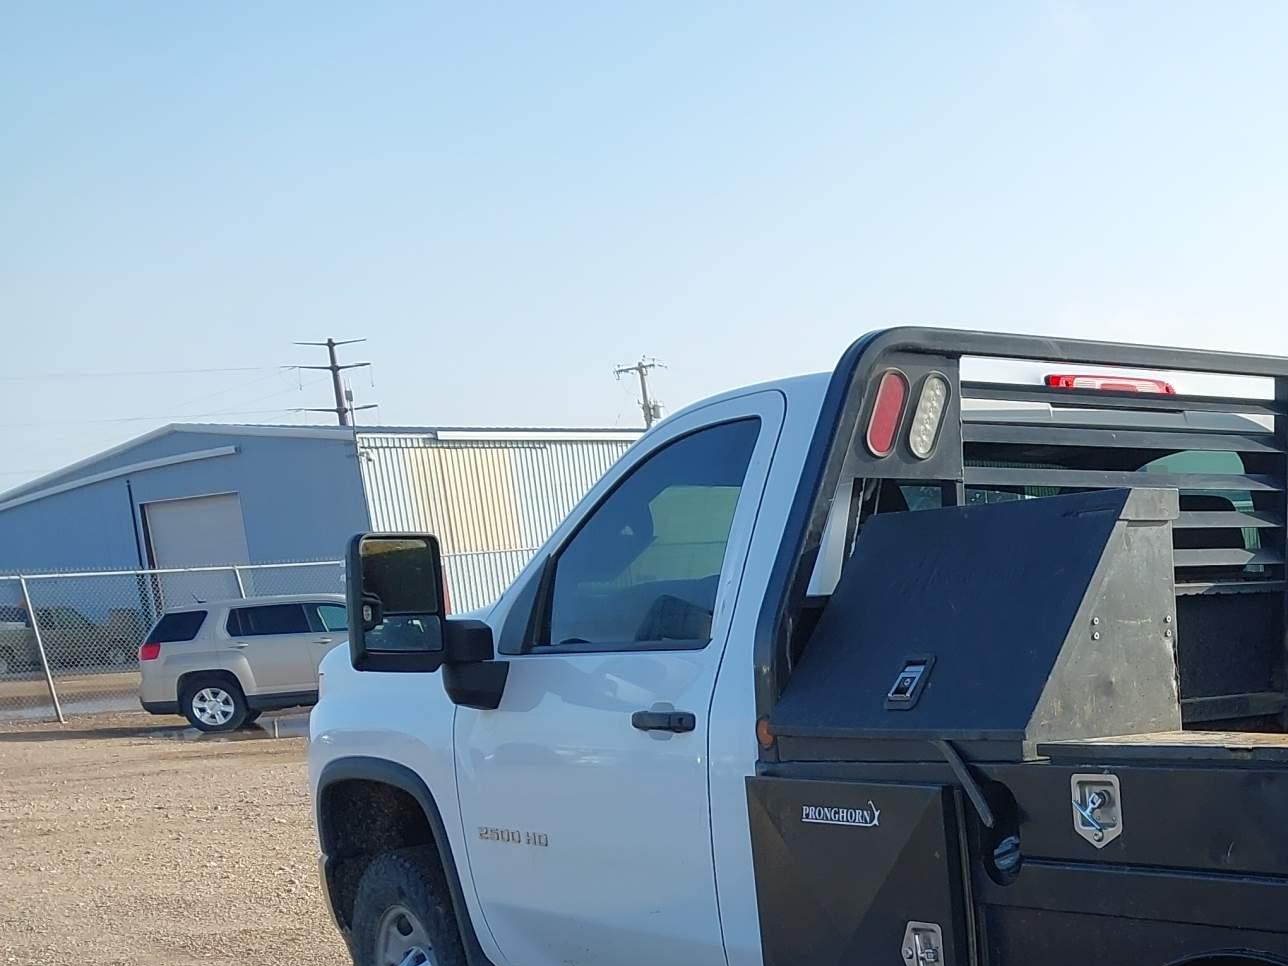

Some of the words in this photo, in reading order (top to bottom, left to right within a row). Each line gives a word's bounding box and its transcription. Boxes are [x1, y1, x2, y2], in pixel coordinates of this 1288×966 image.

[802, 805, 871, 824] PRONGHORN
[479, 826, 521, 844] 2500
[526, 831, 549, 847] HD
